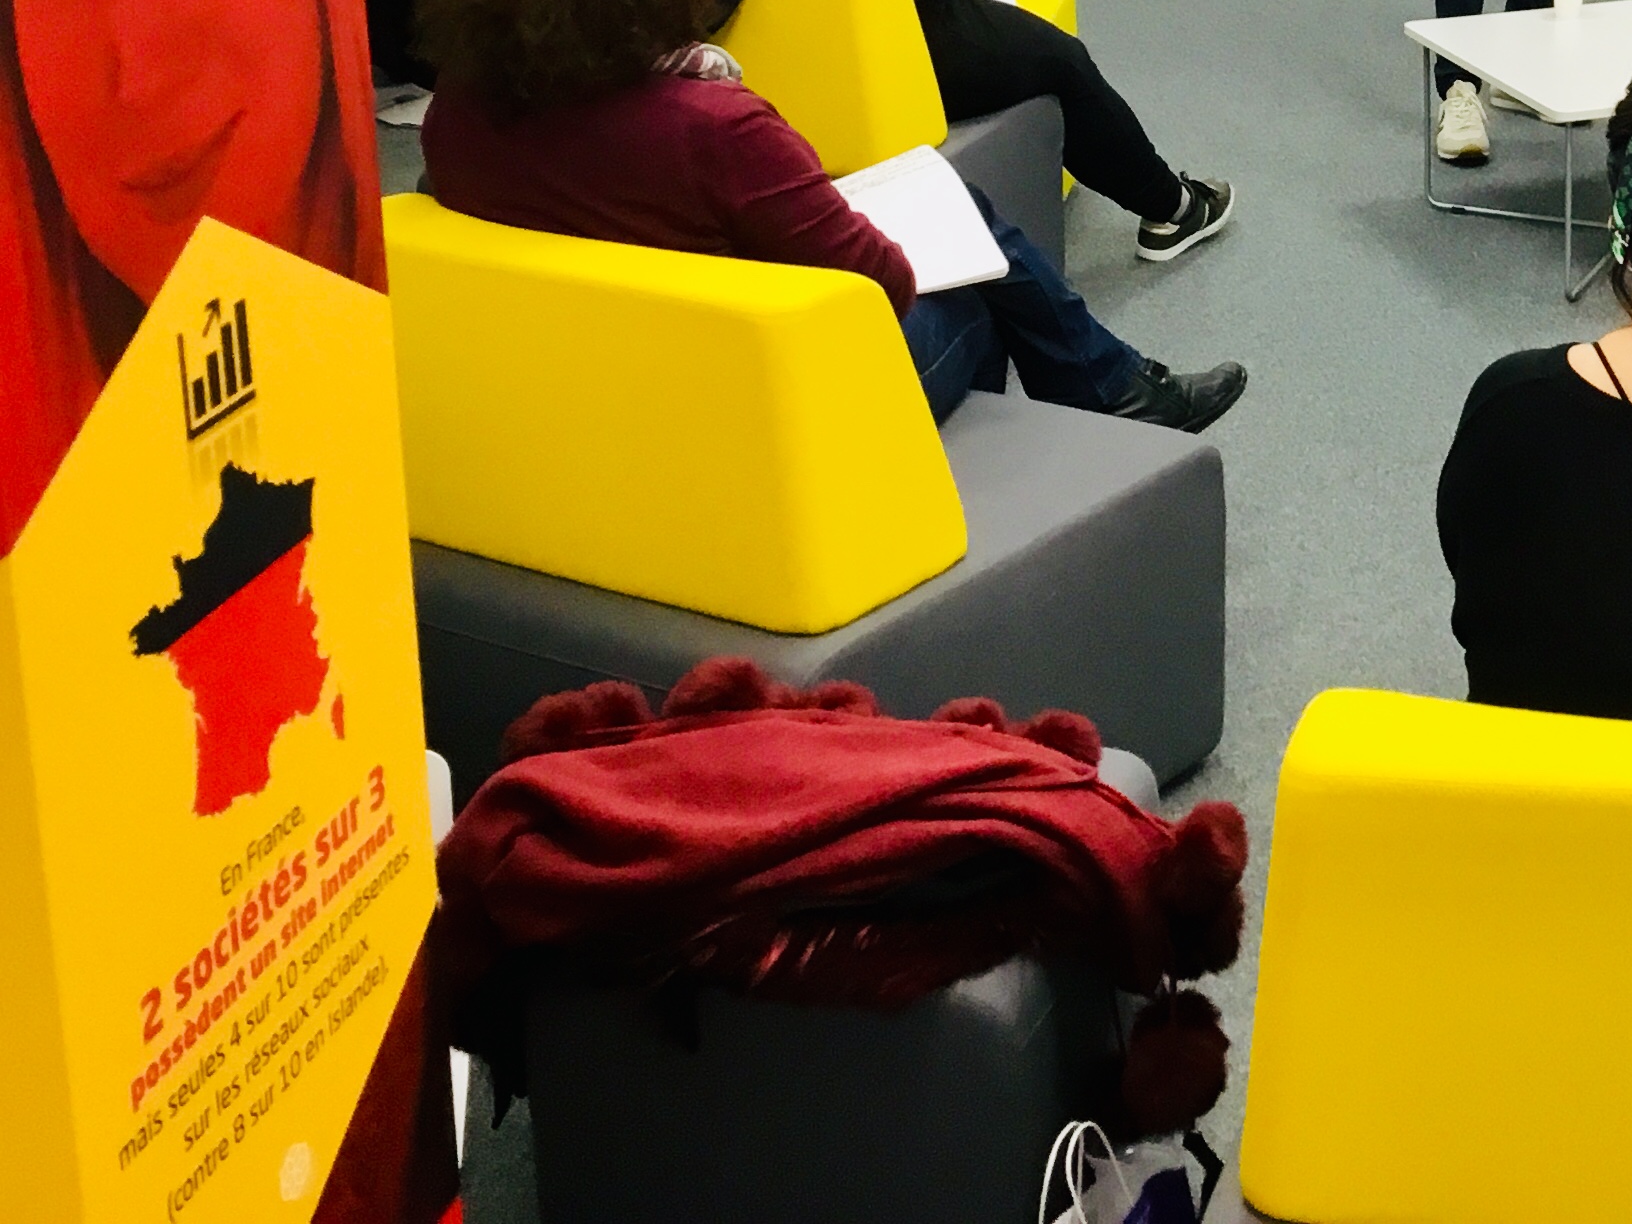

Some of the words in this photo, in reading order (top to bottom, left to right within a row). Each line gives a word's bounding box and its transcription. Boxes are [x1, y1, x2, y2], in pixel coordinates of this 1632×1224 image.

[140, 986, 164, 1046] 2
[174, 849, 307, 1013] sociétés
[315, 795, 360, 869] sur
[367, 764, 386, 812] 3
[220, 863, 243, 896] En
[246, 805, 306, 873] France,
[118, 1110, 163, 1171] mais
[167, 1043, 226, 1120] seules
[229, 1021, 241, 1047] 4
[245, 992, 271, 1035] sur
[276, 960, 298, 1002] 10
[302, 921, 336, 975] sont
[339, 844, 410, 940] présentes
[130, 967, 247, 1114] possèdent
[250, 938, 277, 981] un
[280, 897, 317, 949] site
[183, 1106, 211, 1152] sur
[215, 1075, 241, 1116] les
[244, 999, 310, 1084] réseaux
[312, 933, 369, 1009] sociaux
[167, 1137, 230, 1224] (contre
[232, 1113, 246, 1144] 8
[249, 1083, 275, 1128] sur
[279, 1050, 302, 1093] 10
[305, 1028, 325, 1063] en
